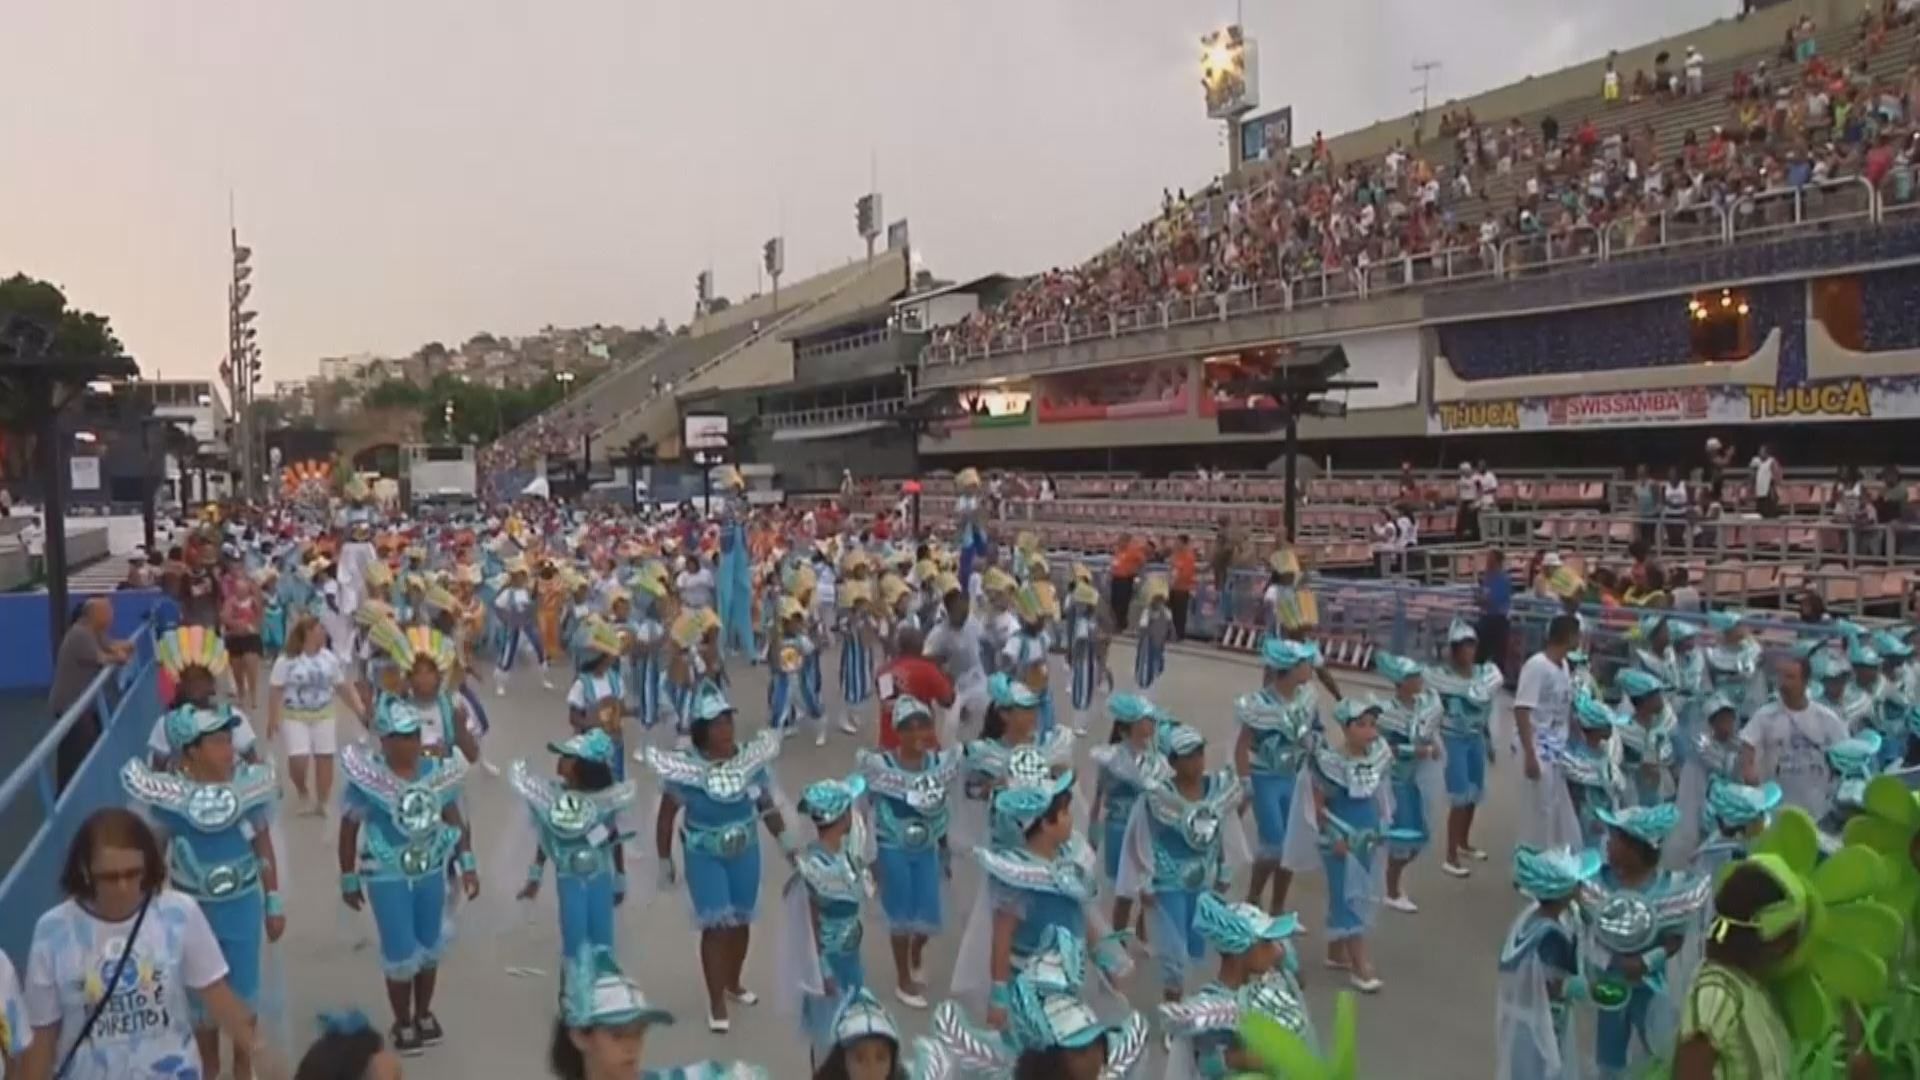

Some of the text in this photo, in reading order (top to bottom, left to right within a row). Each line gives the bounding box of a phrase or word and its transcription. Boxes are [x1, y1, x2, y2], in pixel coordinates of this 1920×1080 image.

[1568, 394, 1681, 416] SWISSAMBA
[1747, 378, 1871, 418] TIJUCA
[1439, 402, 1520, 431] TIJUCA
